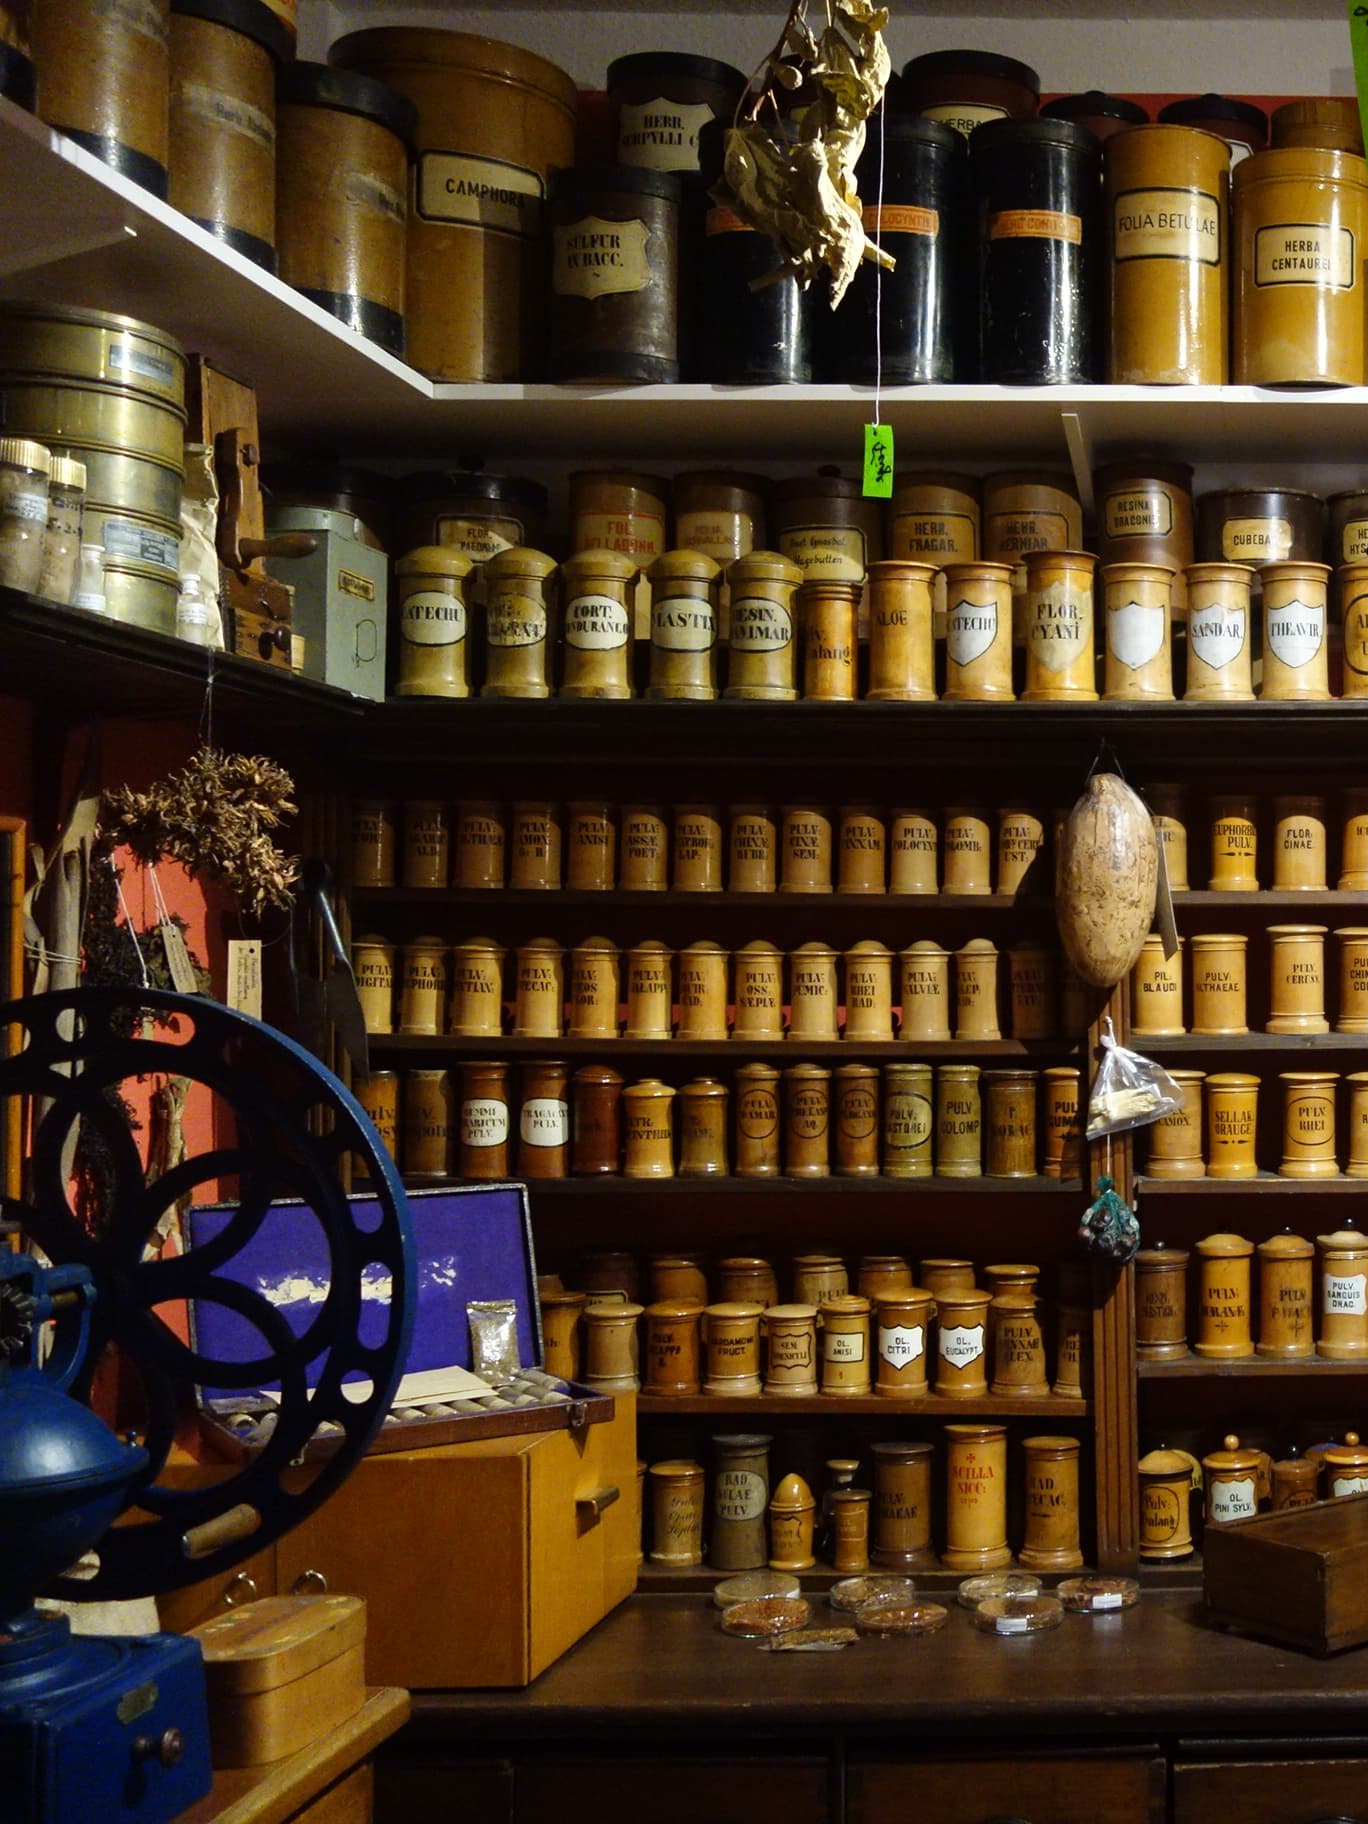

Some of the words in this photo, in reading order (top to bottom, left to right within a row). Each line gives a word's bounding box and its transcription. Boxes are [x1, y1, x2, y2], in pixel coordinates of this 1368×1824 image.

[445, 177, 526, 210] CAMPHORA
[1119, 213, 1155, 236] FOLIA
[1284, 241, 1321, 253] HERBA
[1234, 534, 1271, 546] CUBEBA
[1037, 604, 1082, 620] FLOR.
[1284, 840, 1312, 849] CINAE
[1299, 1120, 1325, 1130] RHEI
[887, 1346, 910, 1354] CITRI
[1215, 1503, 1231, 1512] PINI
